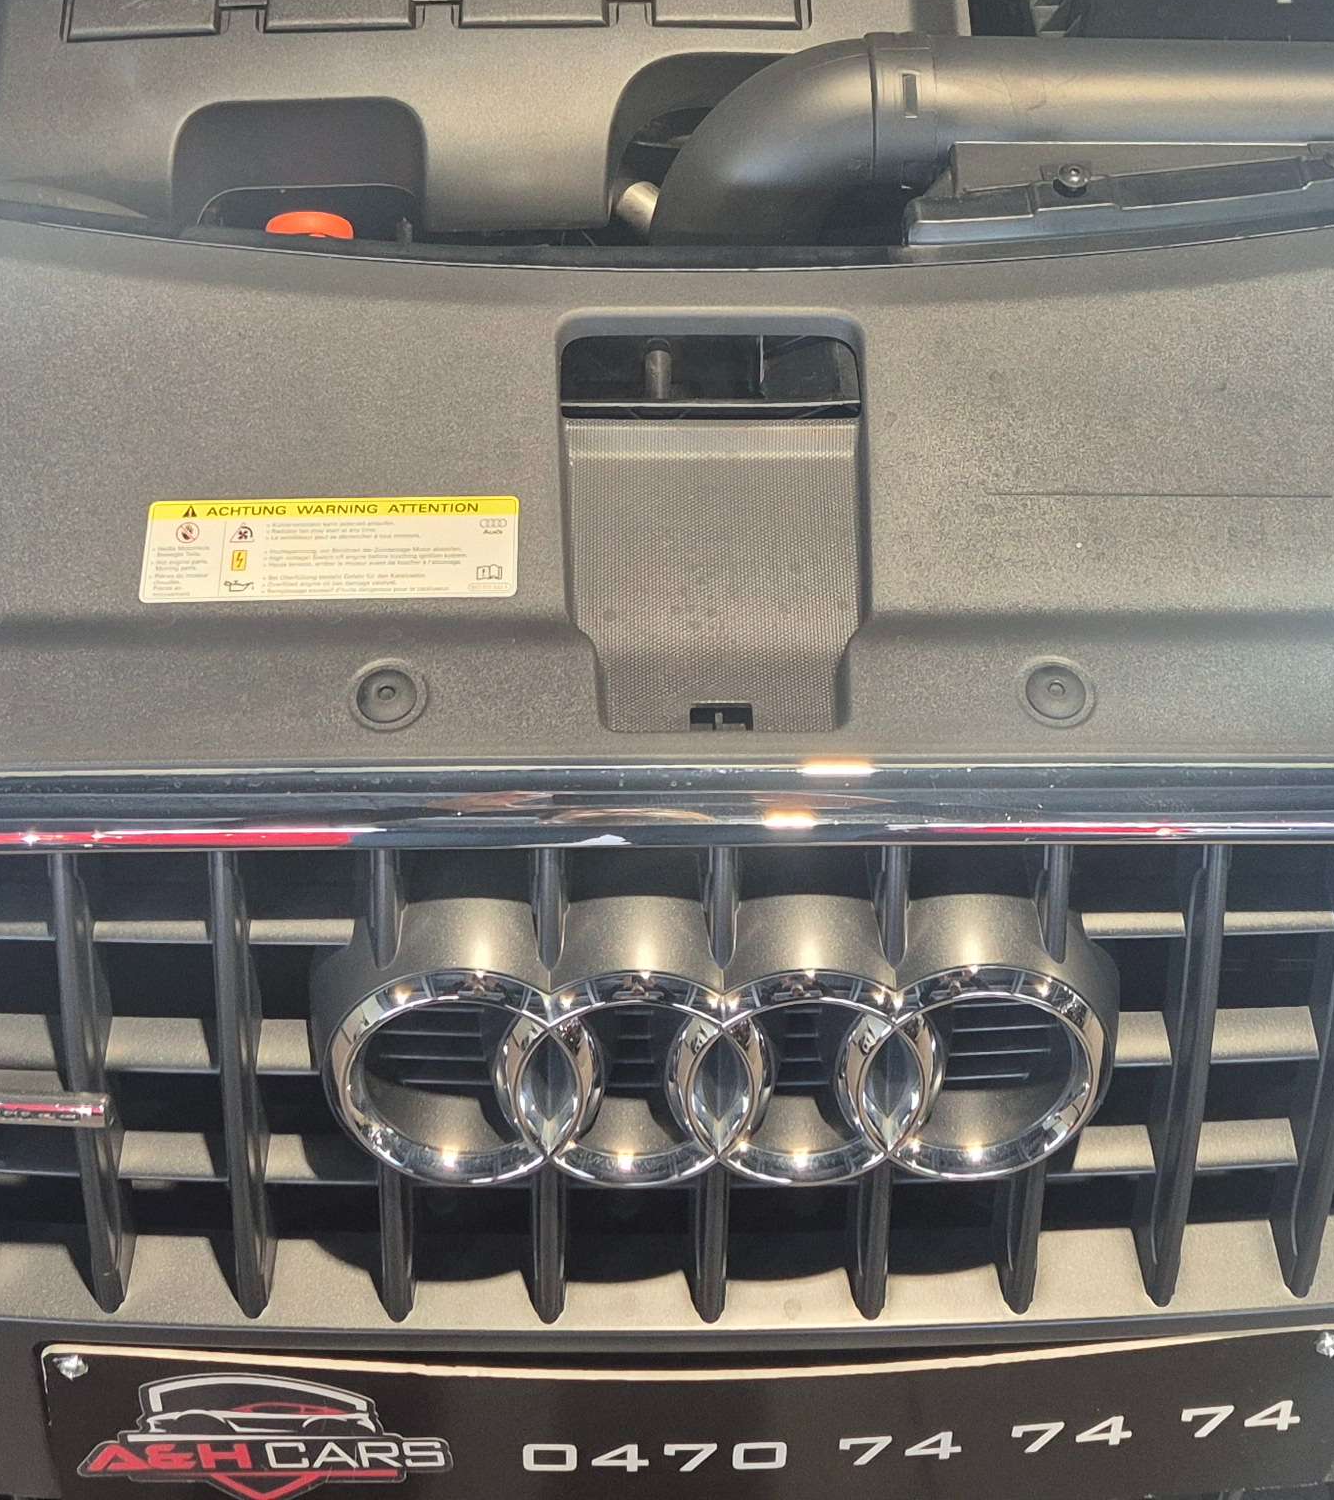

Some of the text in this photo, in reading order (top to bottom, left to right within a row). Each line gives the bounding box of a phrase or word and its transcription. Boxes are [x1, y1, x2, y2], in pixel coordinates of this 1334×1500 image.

[206, 502, 479, 517] ACHTUNG WARNING ATTENTION
[522, 1400, 1301, 1472] 0470 74 74 74
[86, 1441, 446, 1472] A&H CARS
